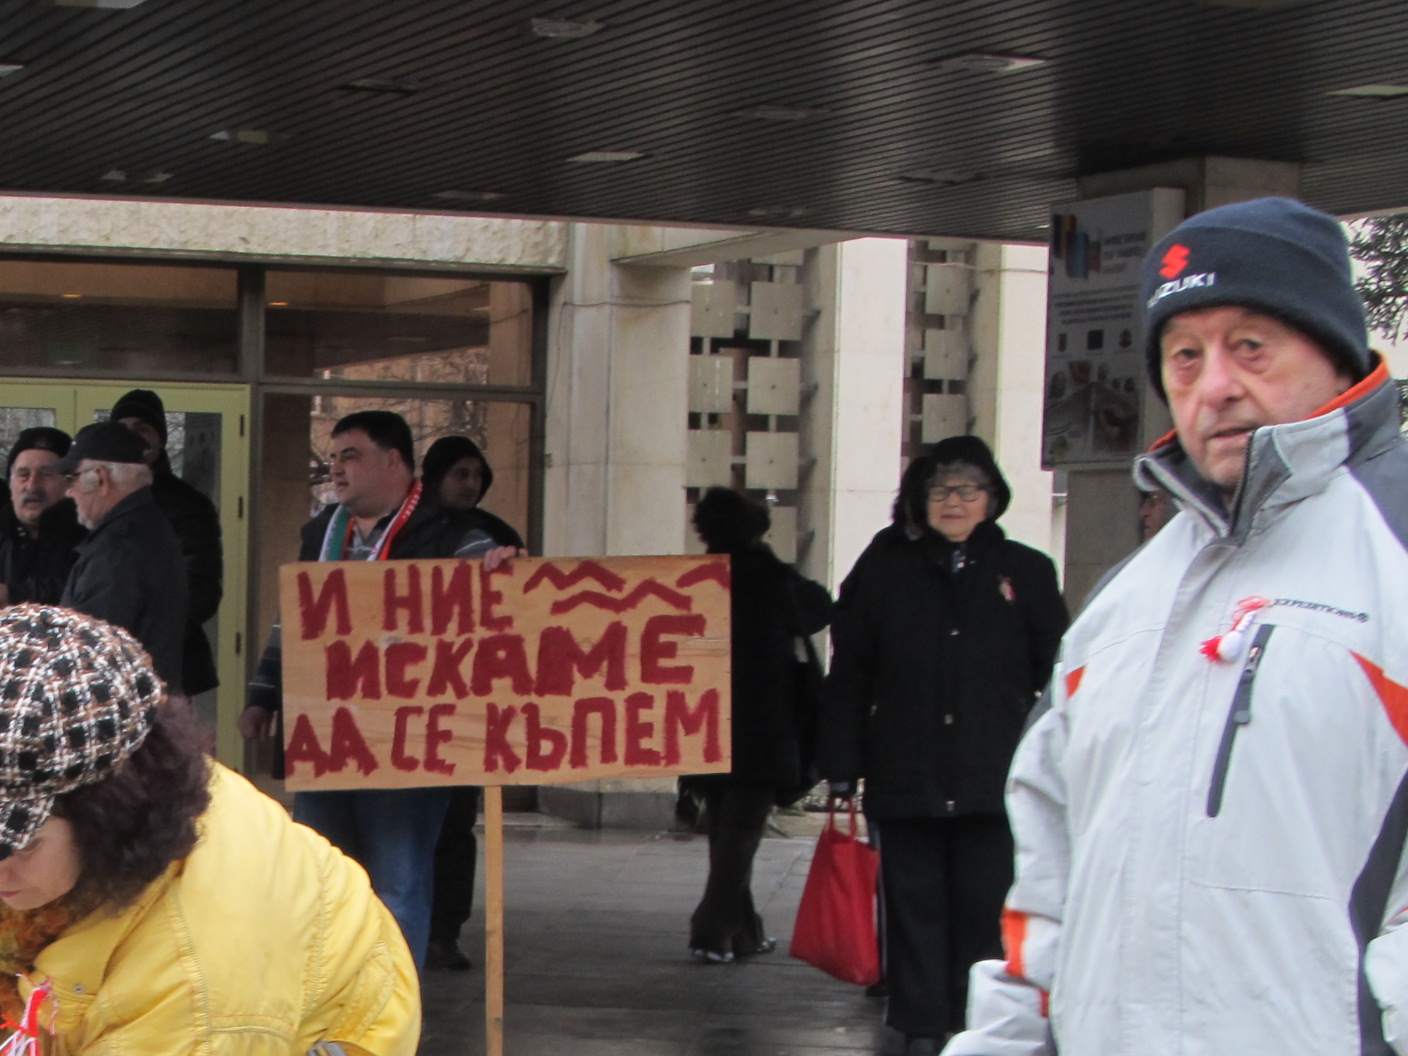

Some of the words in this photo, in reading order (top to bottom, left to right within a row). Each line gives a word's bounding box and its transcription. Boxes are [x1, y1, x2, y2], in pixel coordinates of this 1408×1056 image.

[297, 567, 353, 641] И
[381, 560, 514, 637] НИЕ
[325, 613, 707, 701] ИСКАМЕ
[285, 706, 380, 779] ДА
[391, 703, 457, 776] СЕ
[483, 687, 723, 775] КЪПЕМ
